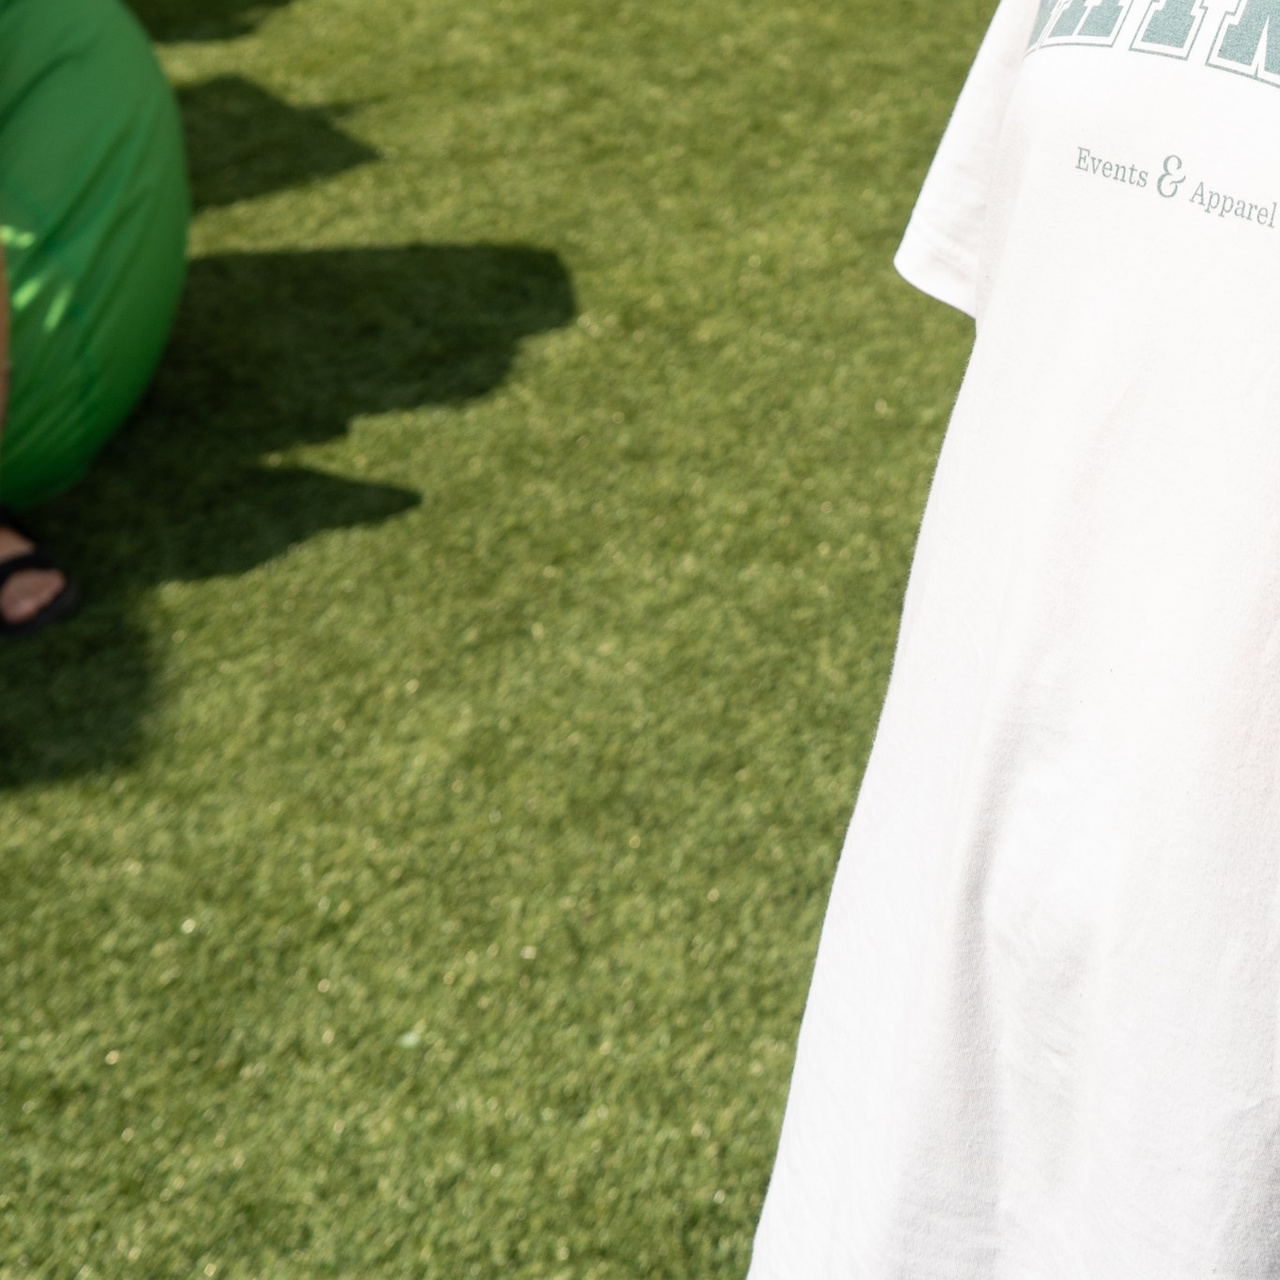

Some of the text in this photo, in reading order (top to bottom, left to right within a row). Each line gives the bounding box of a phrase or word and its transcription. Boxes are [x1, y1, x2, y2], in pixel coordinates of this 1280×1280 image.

[1075, 146, 1278, 229] Events & Apparel
